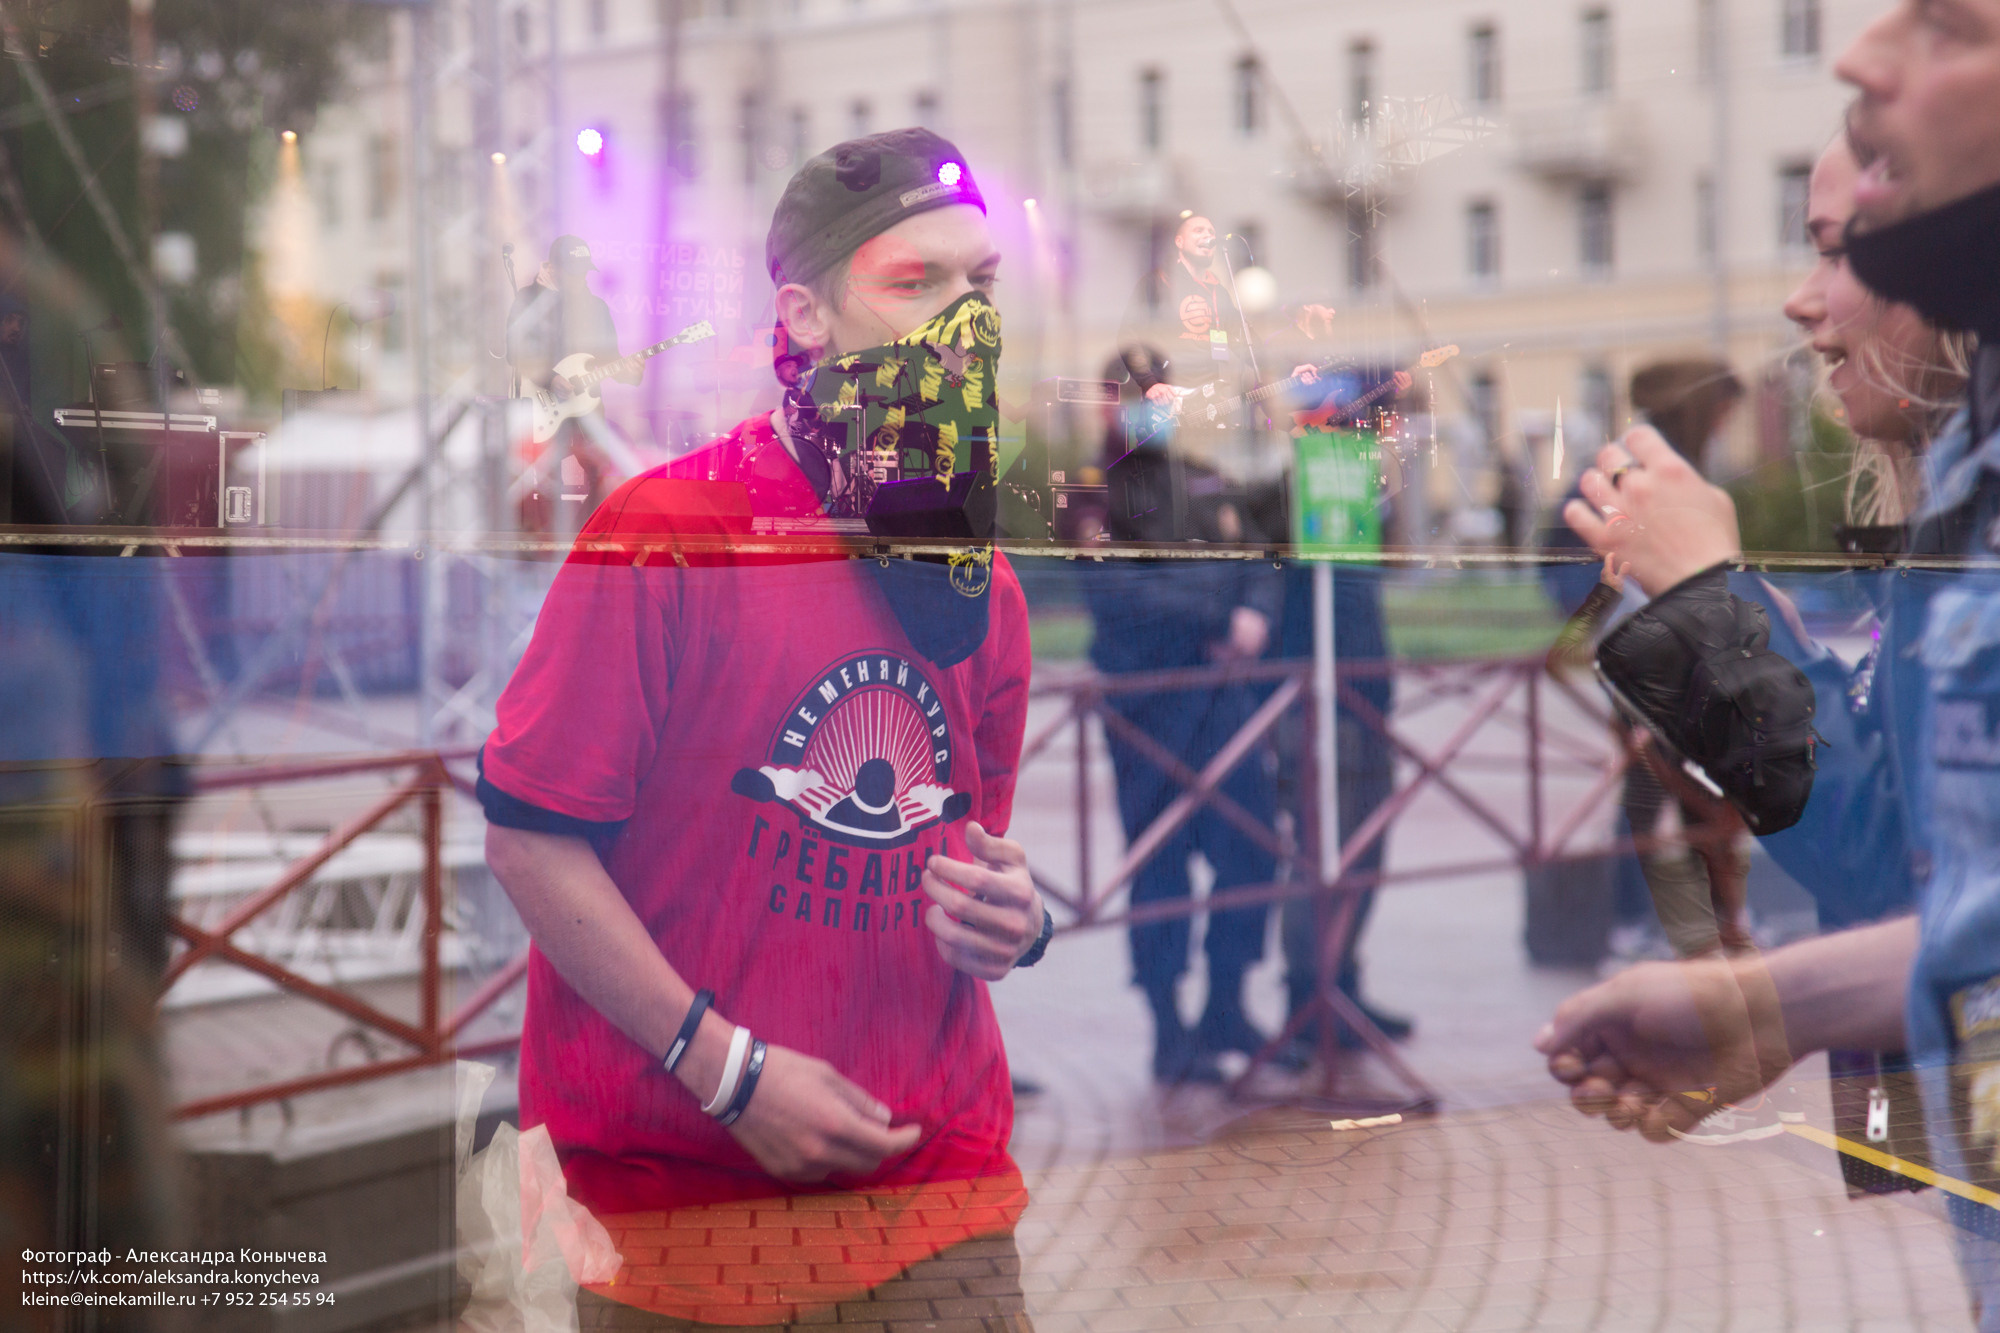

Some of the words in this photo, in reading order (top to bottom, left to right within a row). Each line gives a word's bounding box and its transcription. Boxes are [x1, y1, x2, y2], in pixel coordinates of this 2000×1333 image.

[659, 270, 744, 294] НОВОЙ
[783, 706, 818, 748] НЕ
[818, 659, 909, 705] МЕНЯЙ
[916, 681, 949, 764] КУРС
